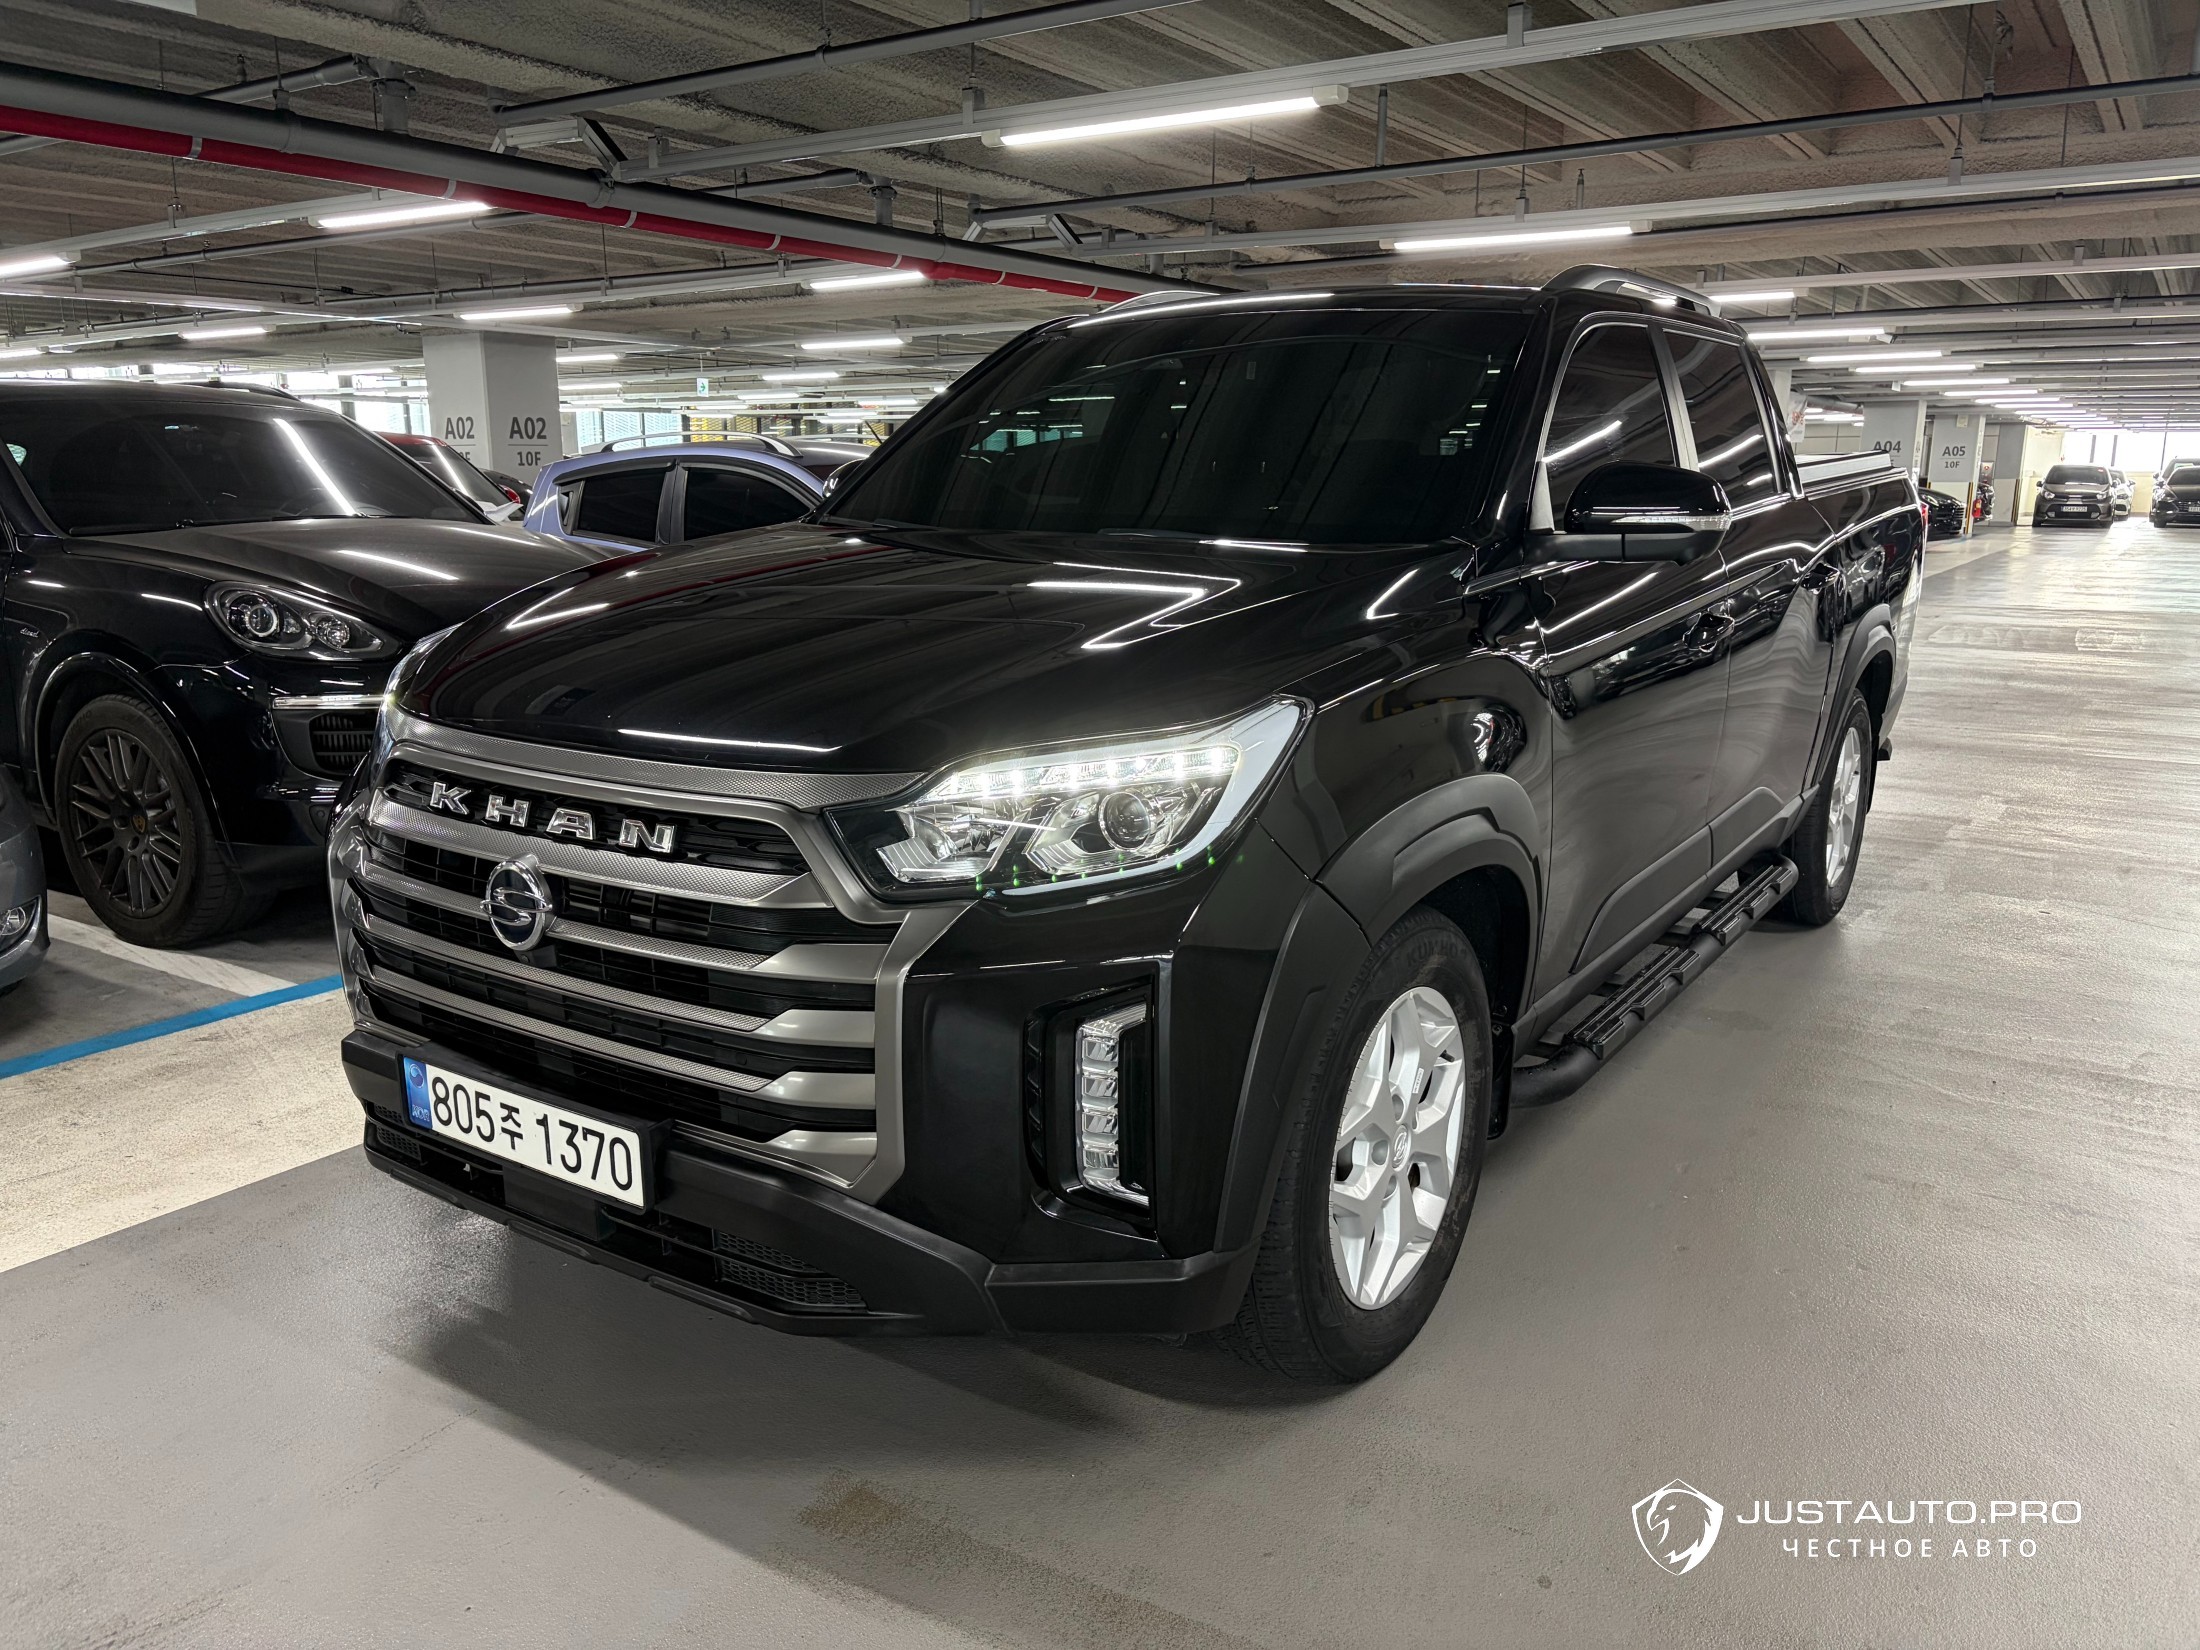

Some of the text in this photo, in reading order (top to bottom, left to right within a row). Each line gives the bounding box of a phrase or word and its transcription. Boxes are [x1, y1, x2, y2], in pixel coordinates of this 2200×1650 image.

[445, 416, 475, 440] A02
[509, 416, 547, 440] A02
[1873, 440, 1902, 453] A04
[1942, 445, 1966, 457] A05
[517, 451, 541, 467] 10F
[1944, 461, 1960, 469] 10F
[430, 781, 678, 854] KHAN
[431, 1076, 633, 1191] 805주 1370
